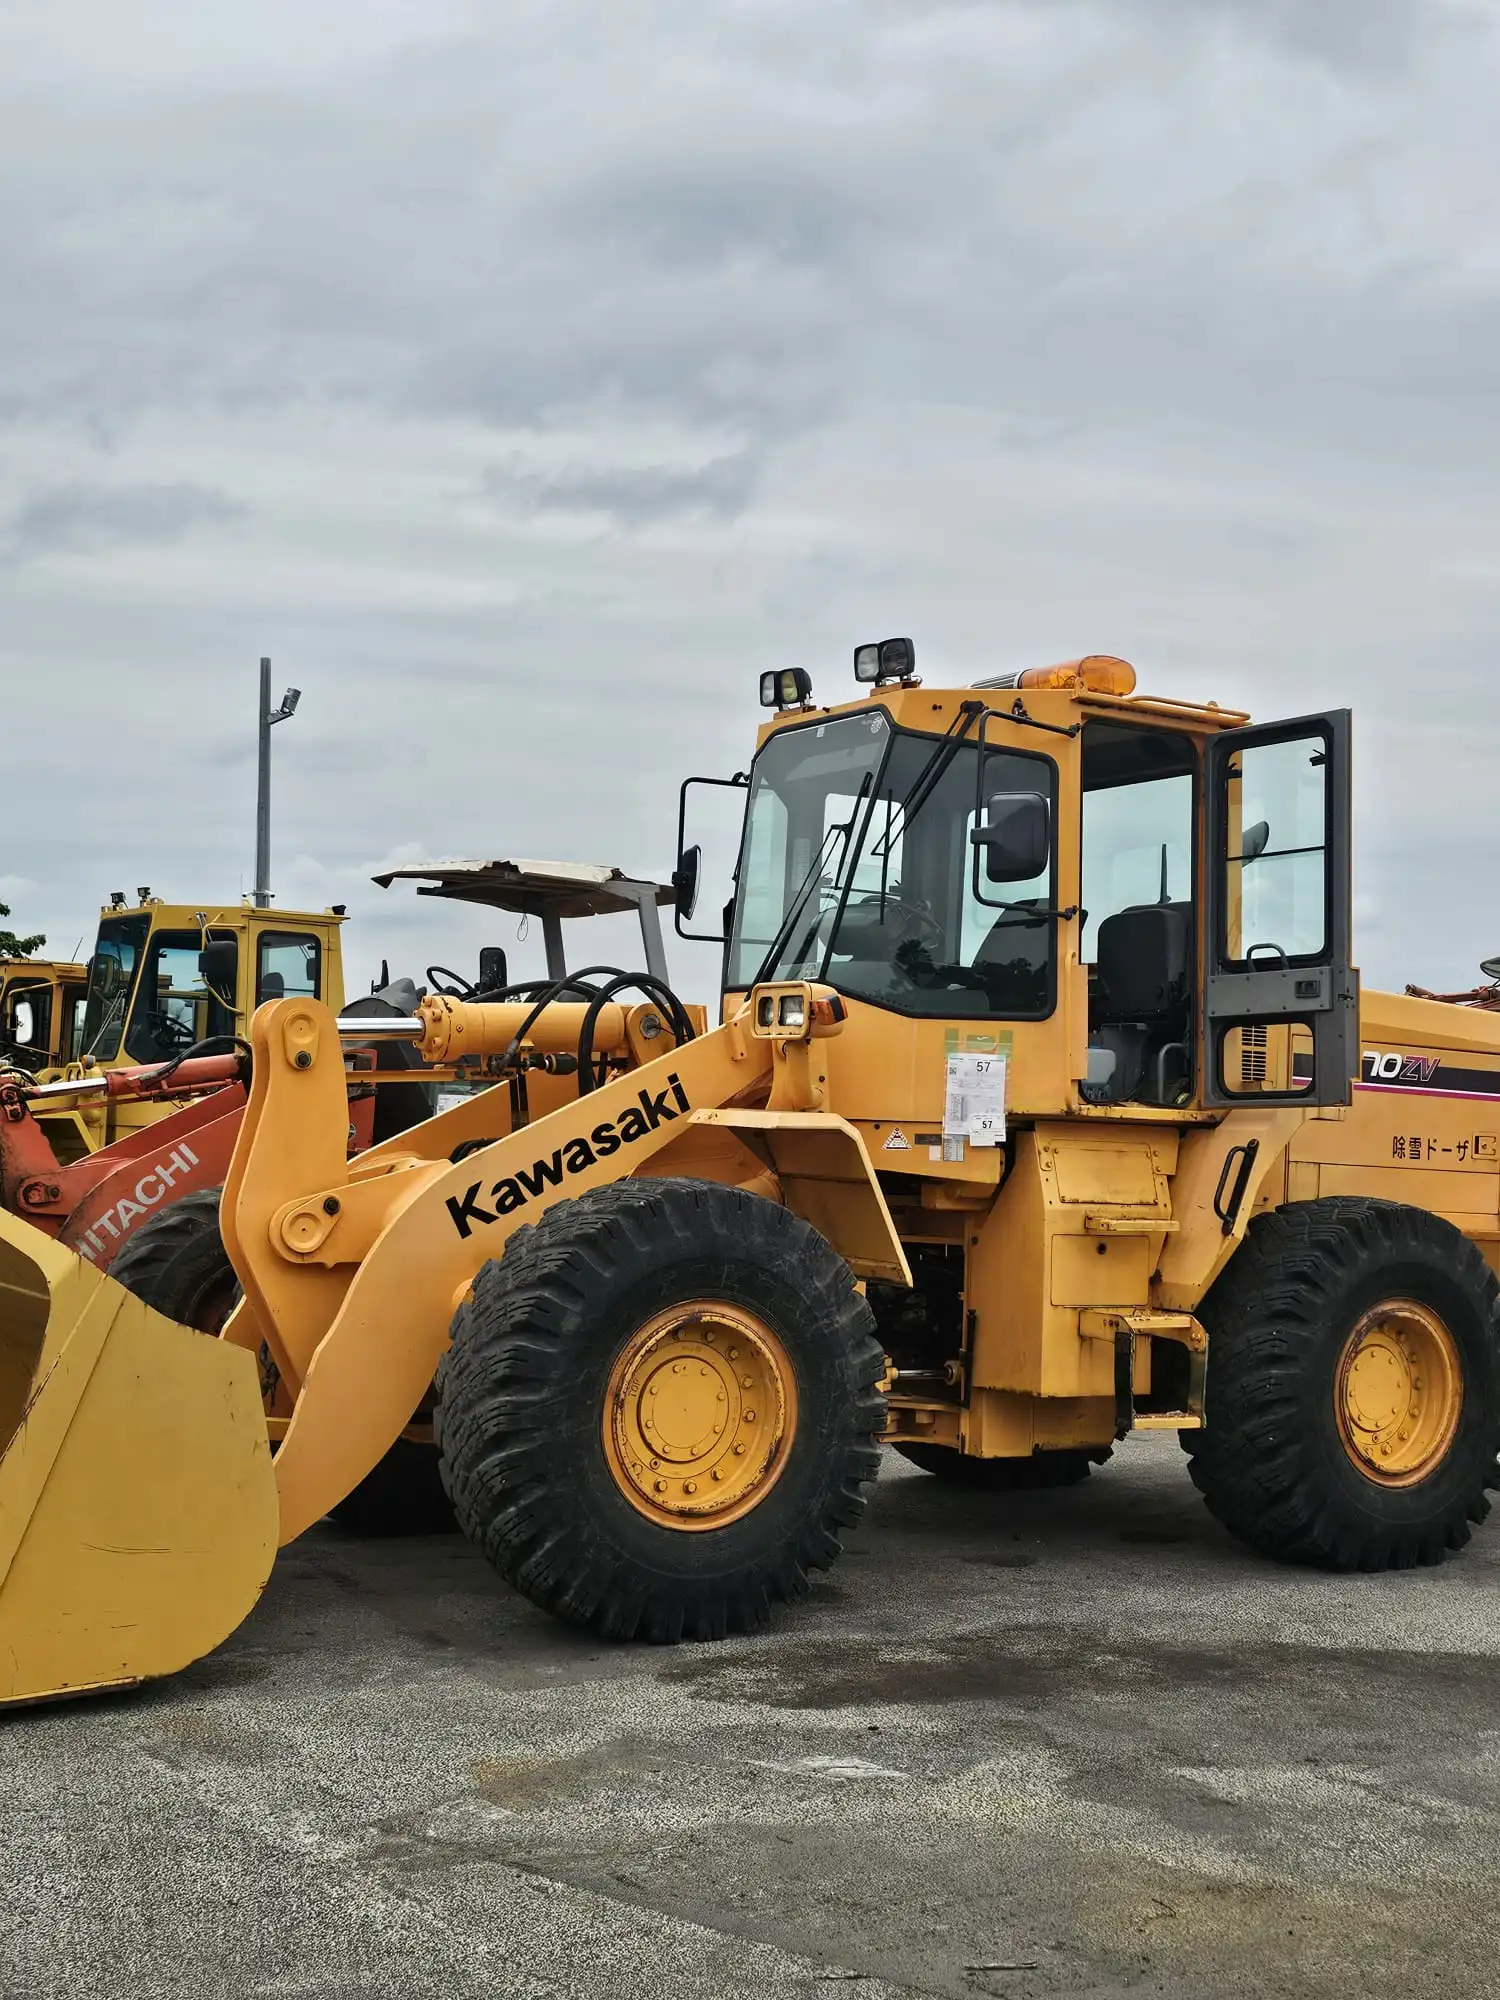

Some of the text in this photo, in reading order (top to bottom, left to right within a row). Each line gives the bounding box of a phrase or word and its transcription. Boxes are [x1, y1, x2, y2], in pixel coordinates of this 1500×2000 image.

[976, 1061, 991, 1073] 57
[982, 1120, 993, 1129] 57
[445, 1072, 691, 1239] Kawasaki
[1392, 1135, 1470, 1162] 除雪ドーザ
